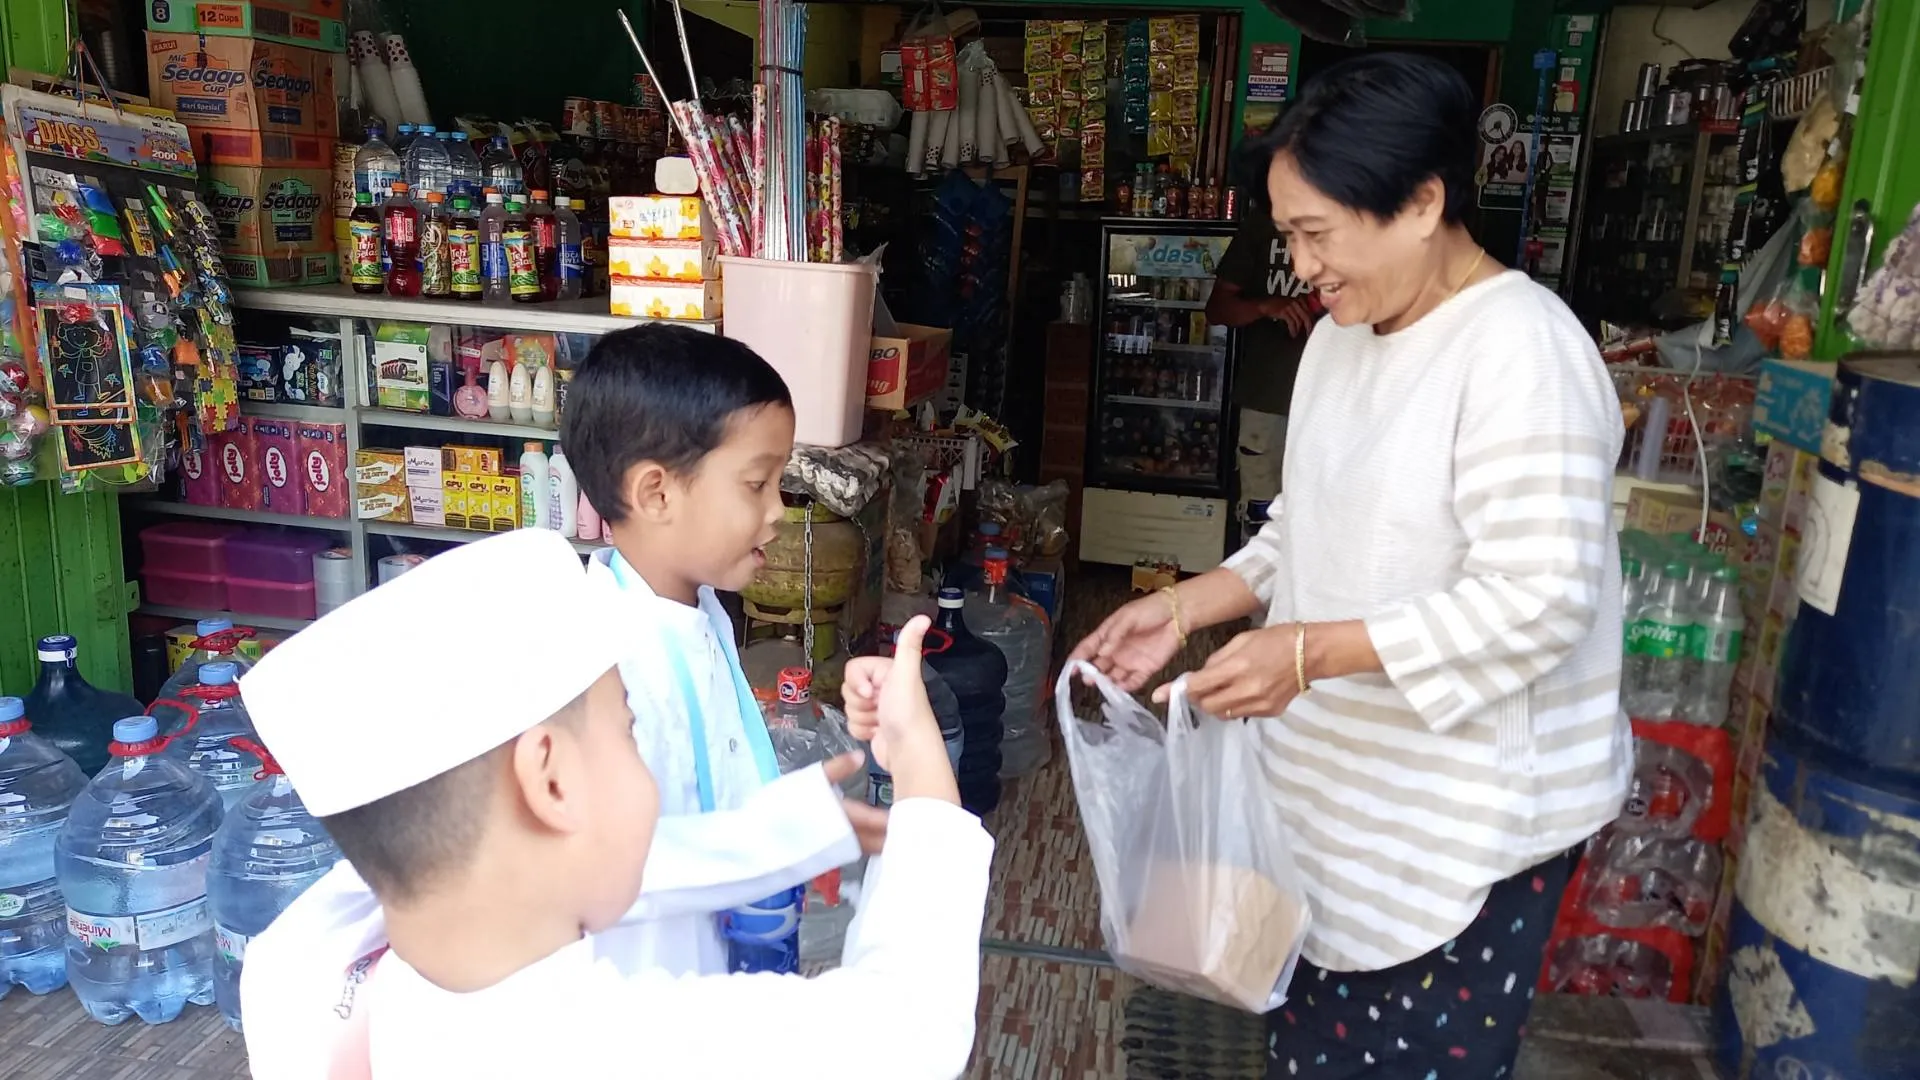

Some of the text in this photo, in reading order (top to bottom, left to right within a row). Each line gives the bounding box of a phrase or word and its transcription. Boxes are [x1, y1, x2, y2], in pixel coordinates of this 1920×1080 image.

[155, 7, 167, 20] 8
[200, 11, 239, 24] 12 Cups
[168, 54, 187, 63] Mie
[162, 63, 246, 89] Sedaap
[202, 84, 226, 94] Cup
[254, 69, 311, 97] Sedaap
[152, 149, 178, 161] 2000
[262, 191, 322, 213] Sedaap
[296, 210, 312, 222] Cup
[357, 241, 376, 250] Teh
[1269, 238, 1289, 265] H
[451, 249, 467, 258] Teh
[512, 251, 528, 260] Teh
[1267, 269, 1315, 298] WA
[869, 347, 898, 359] BO
[227, 448, 242, 478] jolly
[270, 452, 284, 482] jolly
[407, 457, 435, 467] Marina
[312, 456, 327, 486] jolly
[445, 480, 463, 488] GPU
[470, 482, 487, 490] GPU
[494, 484, 511, 493] GPU
[69, 917, 112, 938] Minerale
[79, 933, 91, 947] Le
